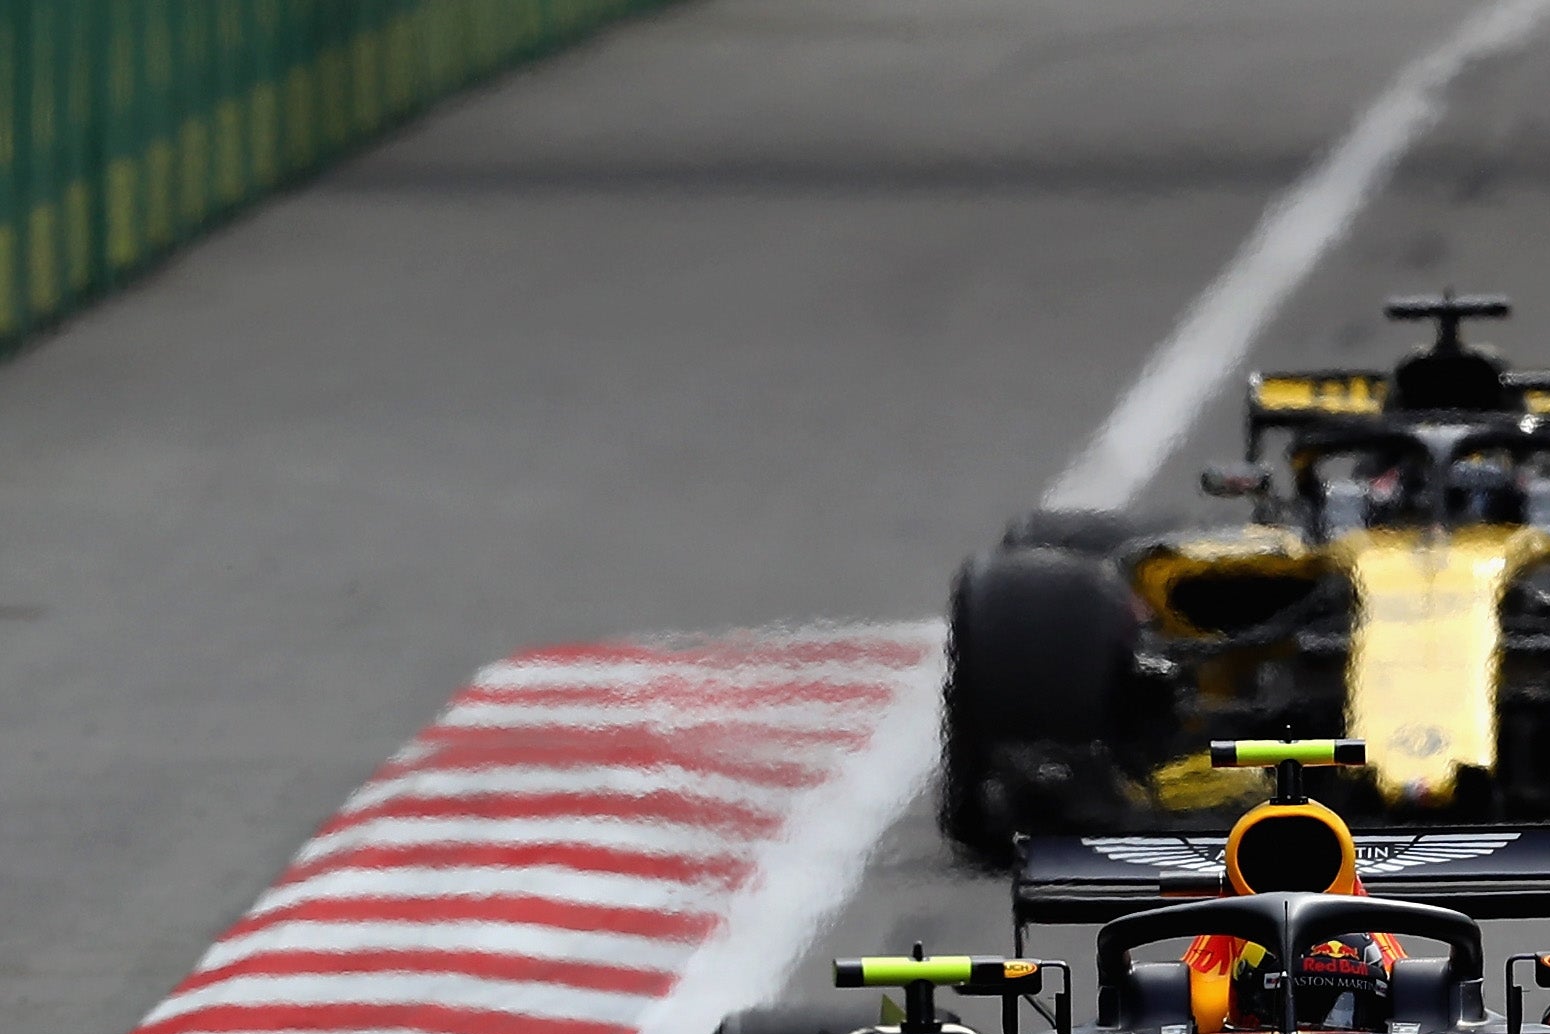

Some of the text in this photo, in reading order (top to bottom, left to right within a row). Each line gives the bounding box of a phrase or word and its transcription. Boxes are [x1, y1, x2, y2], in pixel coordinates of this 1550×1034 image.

[1353, 847, 1388, 858] TIN
[1304, 957, 1369, 975] Red Bull
